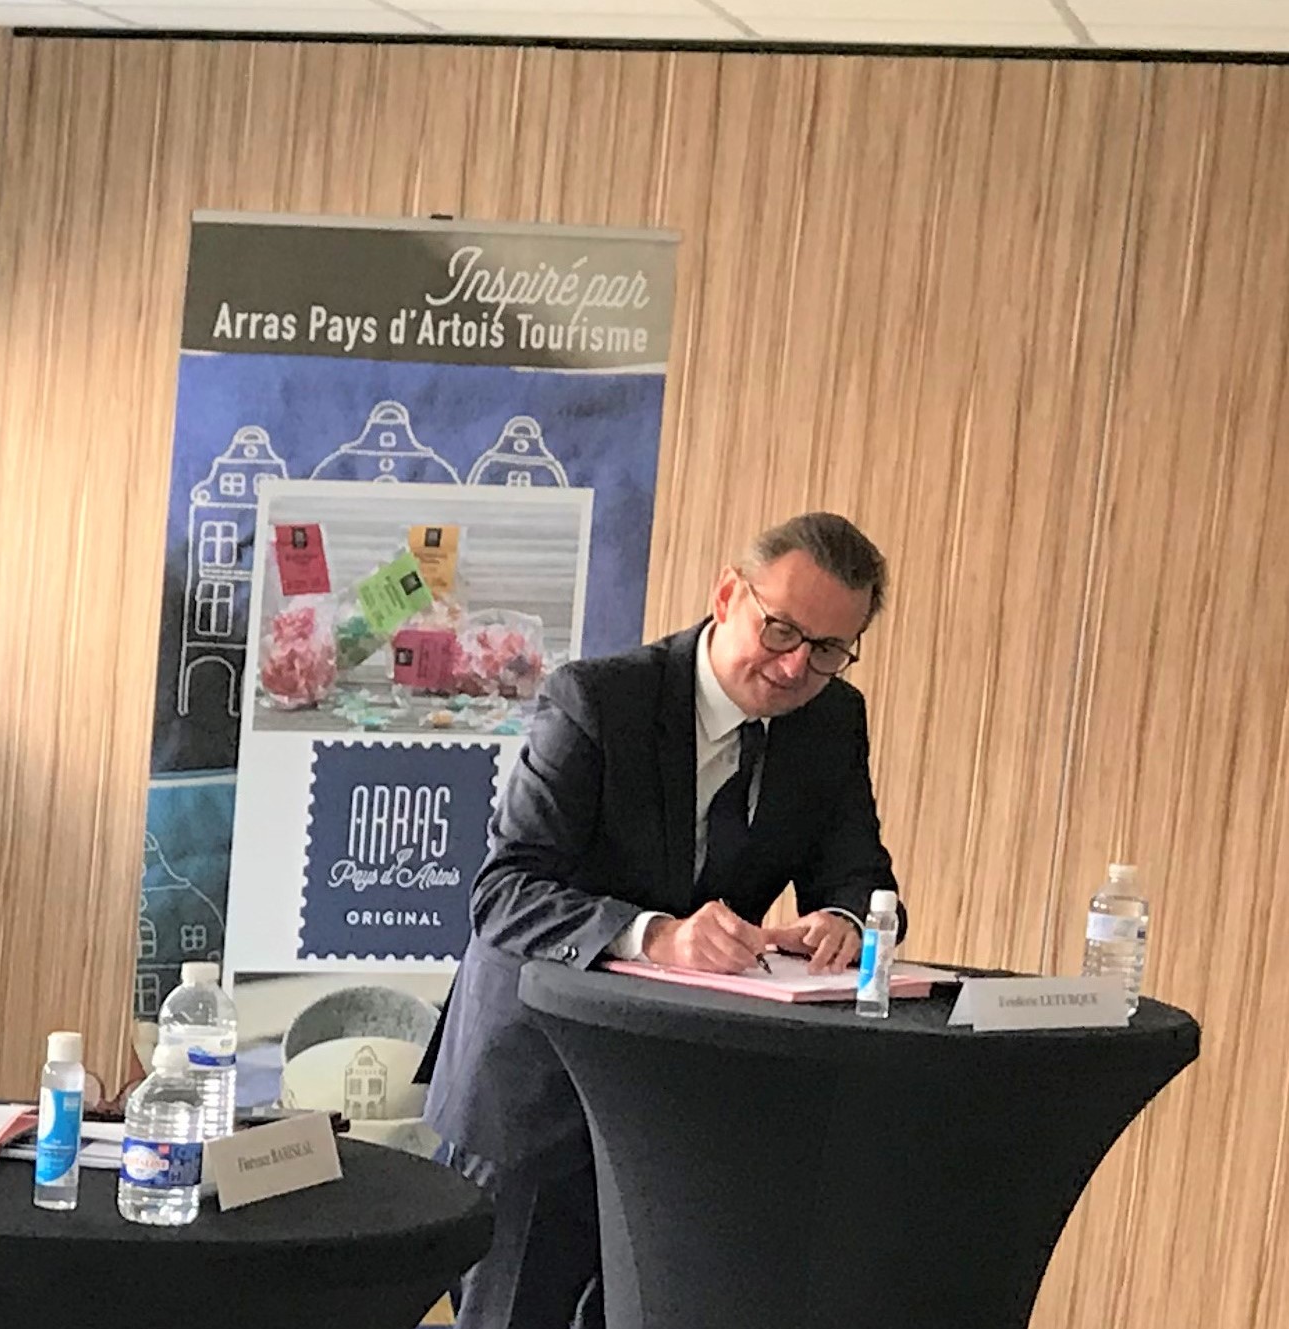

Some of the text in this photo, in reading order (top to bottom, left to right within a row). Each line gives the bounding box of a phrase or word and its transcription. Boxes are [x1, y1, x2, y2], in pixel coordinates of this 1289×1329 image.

[425, 246, 650, 326] Inspiré par
[212, 302, 648, 353] Arras Pays d'Artois Tourisme
[348, 785, 451, 864] ARRAS
[328, 859, 378, 892] Pays
[346, 911, 442, 926] ORIGINAL
